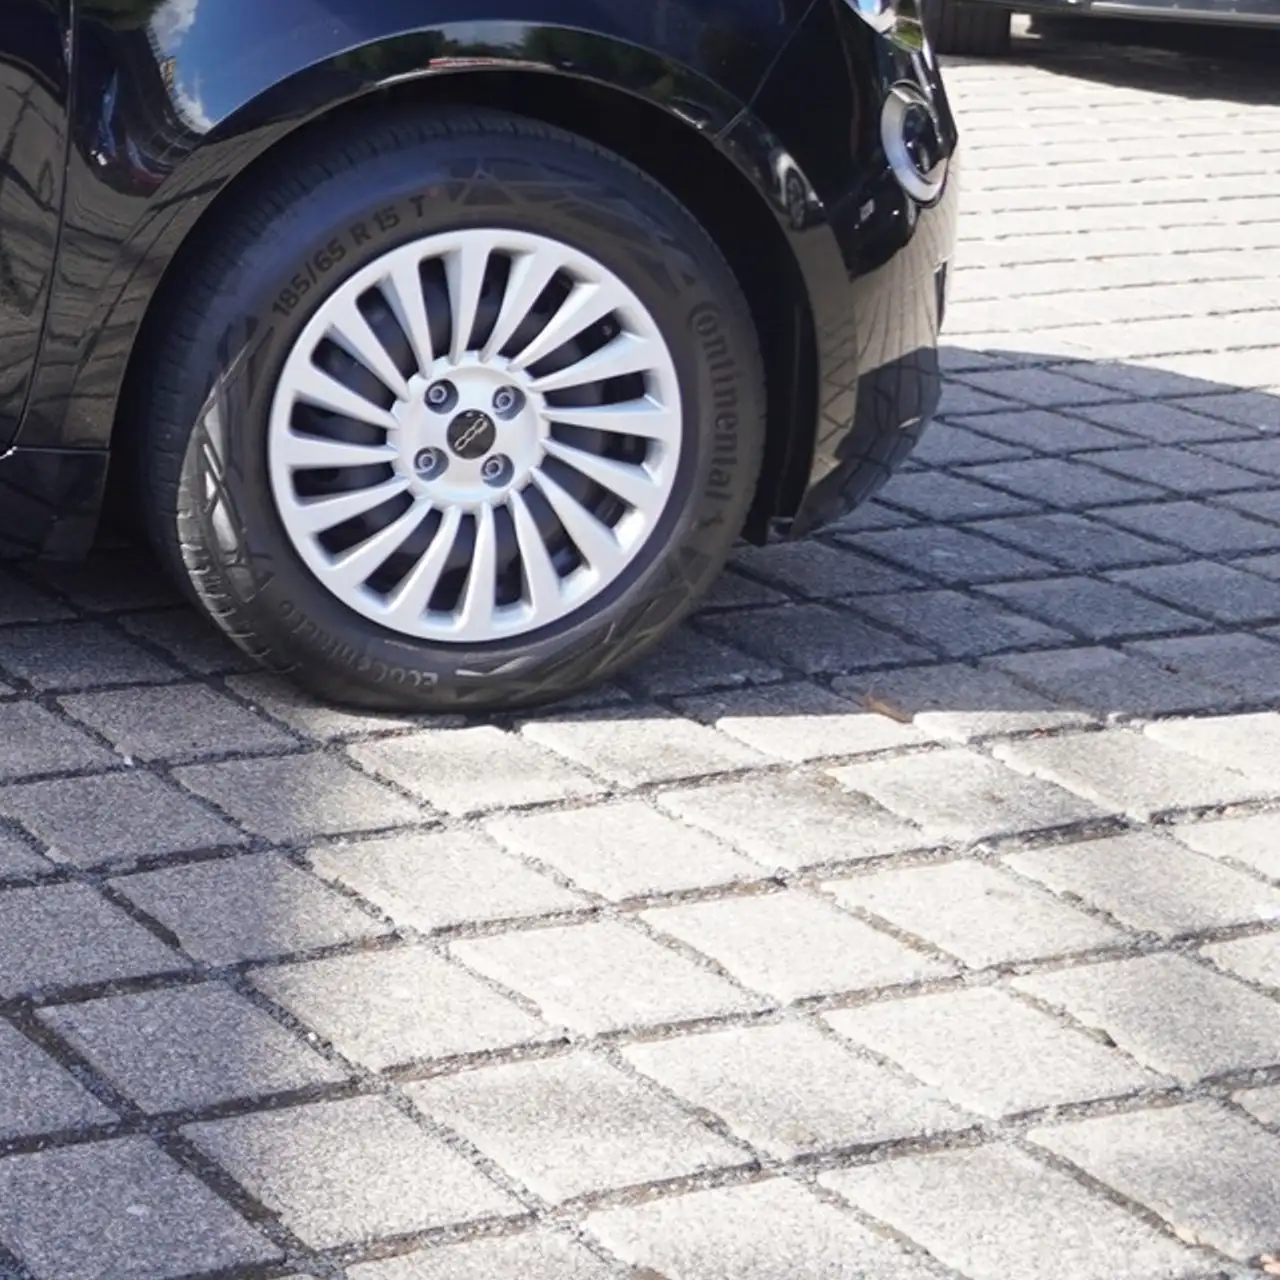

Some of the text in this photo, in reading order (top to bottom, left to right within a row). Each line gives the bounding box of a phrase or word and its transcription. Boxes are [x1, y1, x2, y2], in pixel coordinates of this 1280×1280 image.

[272, 236, 347, 317] 185/65
[349, 222, 372, 247] R
[373, 205, 400, 233] 15
[688, 300, 739, 502] Continental
